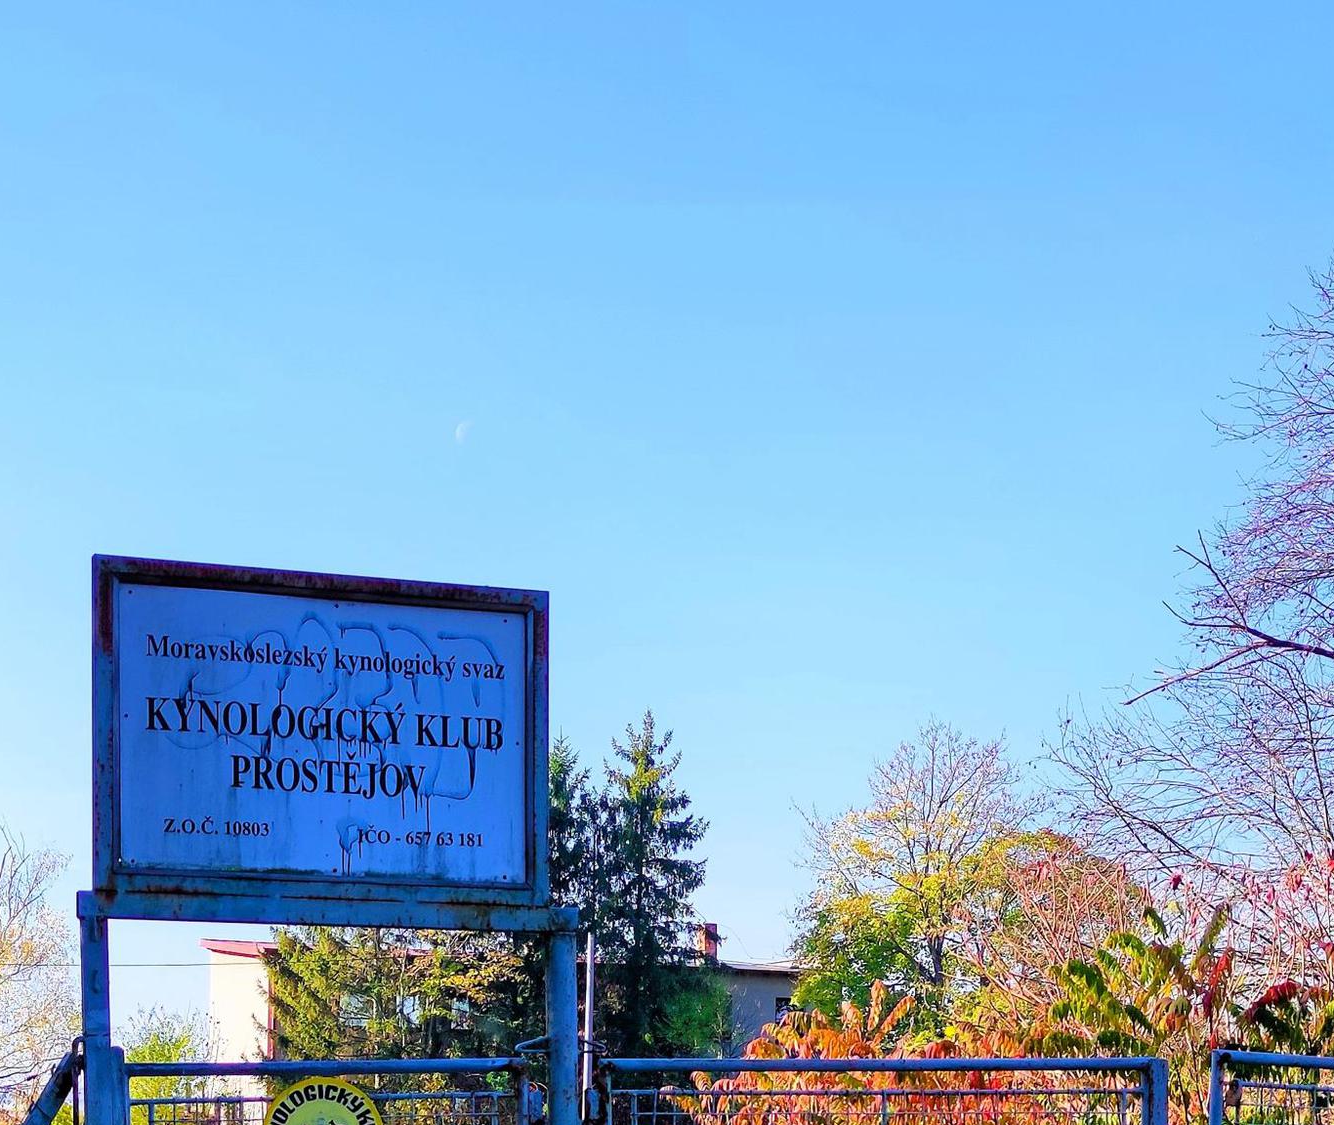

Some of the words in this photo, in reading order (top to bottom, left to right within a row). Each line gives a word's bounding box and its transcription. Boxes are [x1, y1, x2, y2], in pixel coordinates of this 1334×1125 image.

[145, 633, 327, 674] Moravskoslezský
[334, 647, 456, 683] kynologický
[462, 661, 506, 681] svaz
[144, 696, 407, 746] KYNOLOGICKÝ
[414, 713, 504, 751] KLUB
[230, 751, 427, 800] PROSTĚJOV
[163, 815, 219, 836] Z.O.Č.
[224, 820, 270, 837] 10803
[358, 824, 391, 845] IČO
[405, 830, 431, 847] 657
[436, 831, 454, 847] 63
[458, 832, 484, 848] 181
